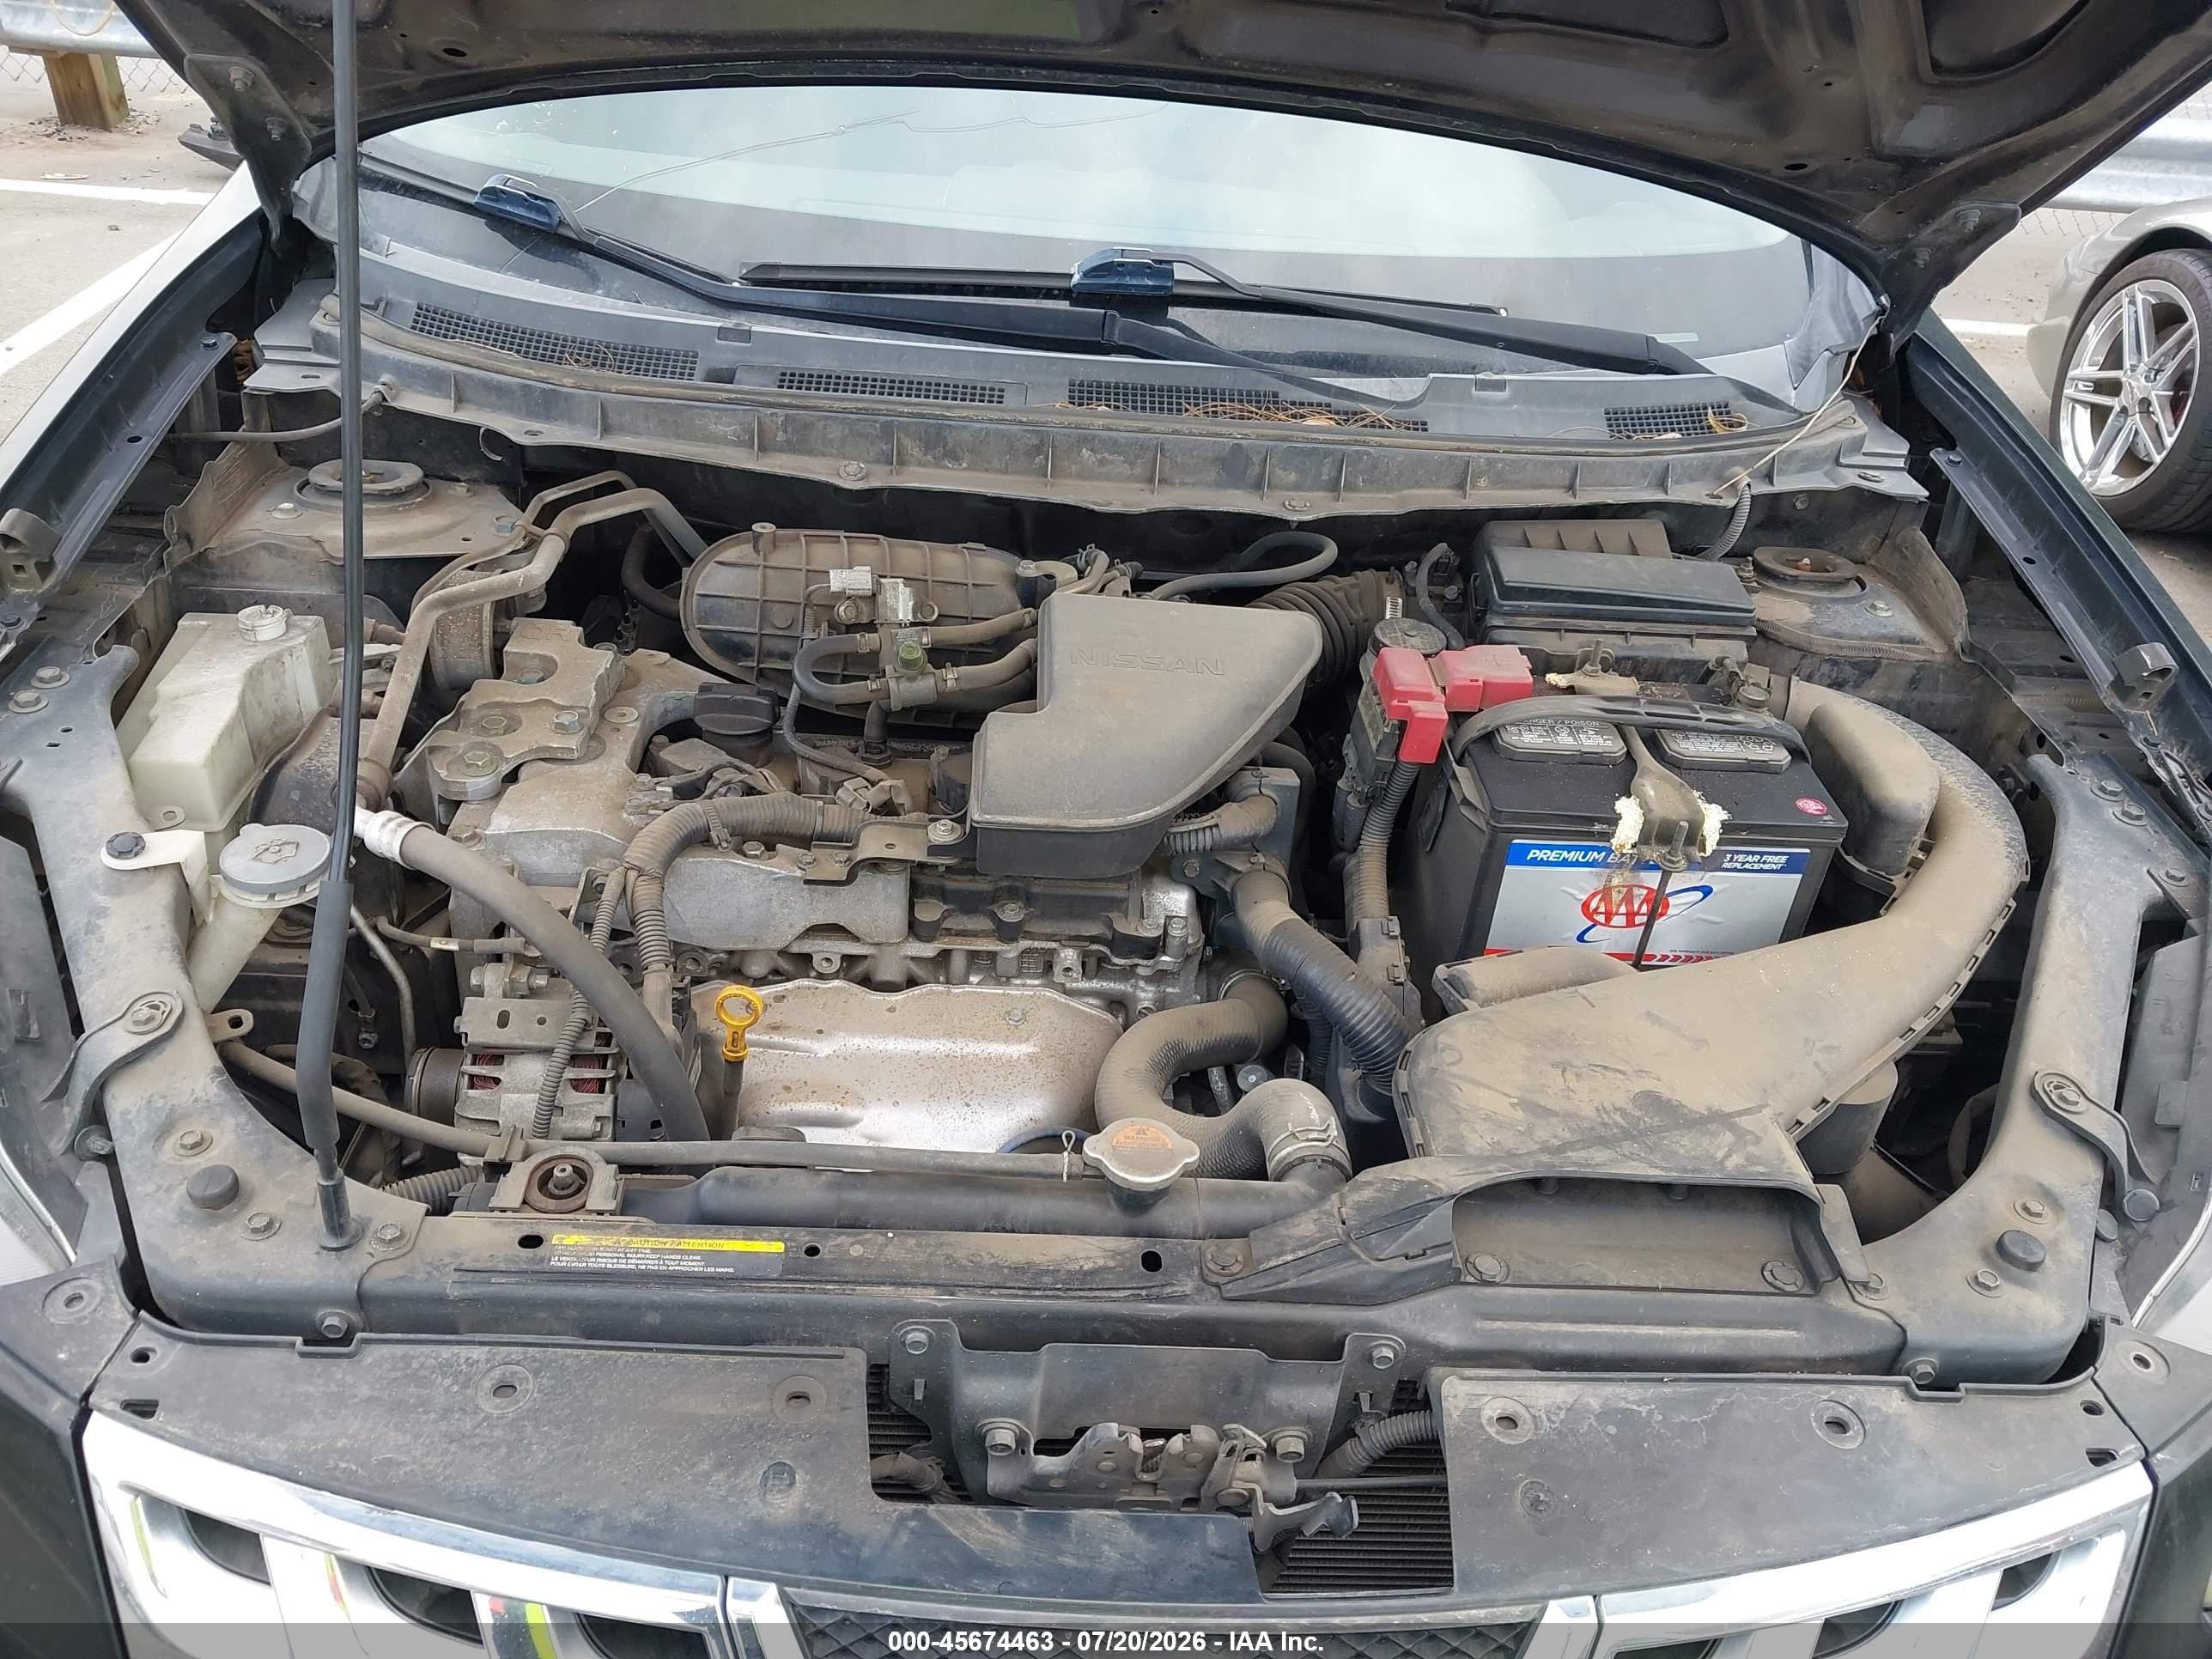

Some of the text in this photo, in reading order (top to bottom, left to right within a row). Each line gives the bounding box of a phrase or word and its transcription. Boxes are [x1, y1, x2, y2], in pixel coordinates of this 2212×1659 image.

[1070, 647, 1224, 676] NISSAN
[1527, 849, 1607, 863] PREMIUM
[1723, 854, 1790, 864] 3 YEAR FREE
